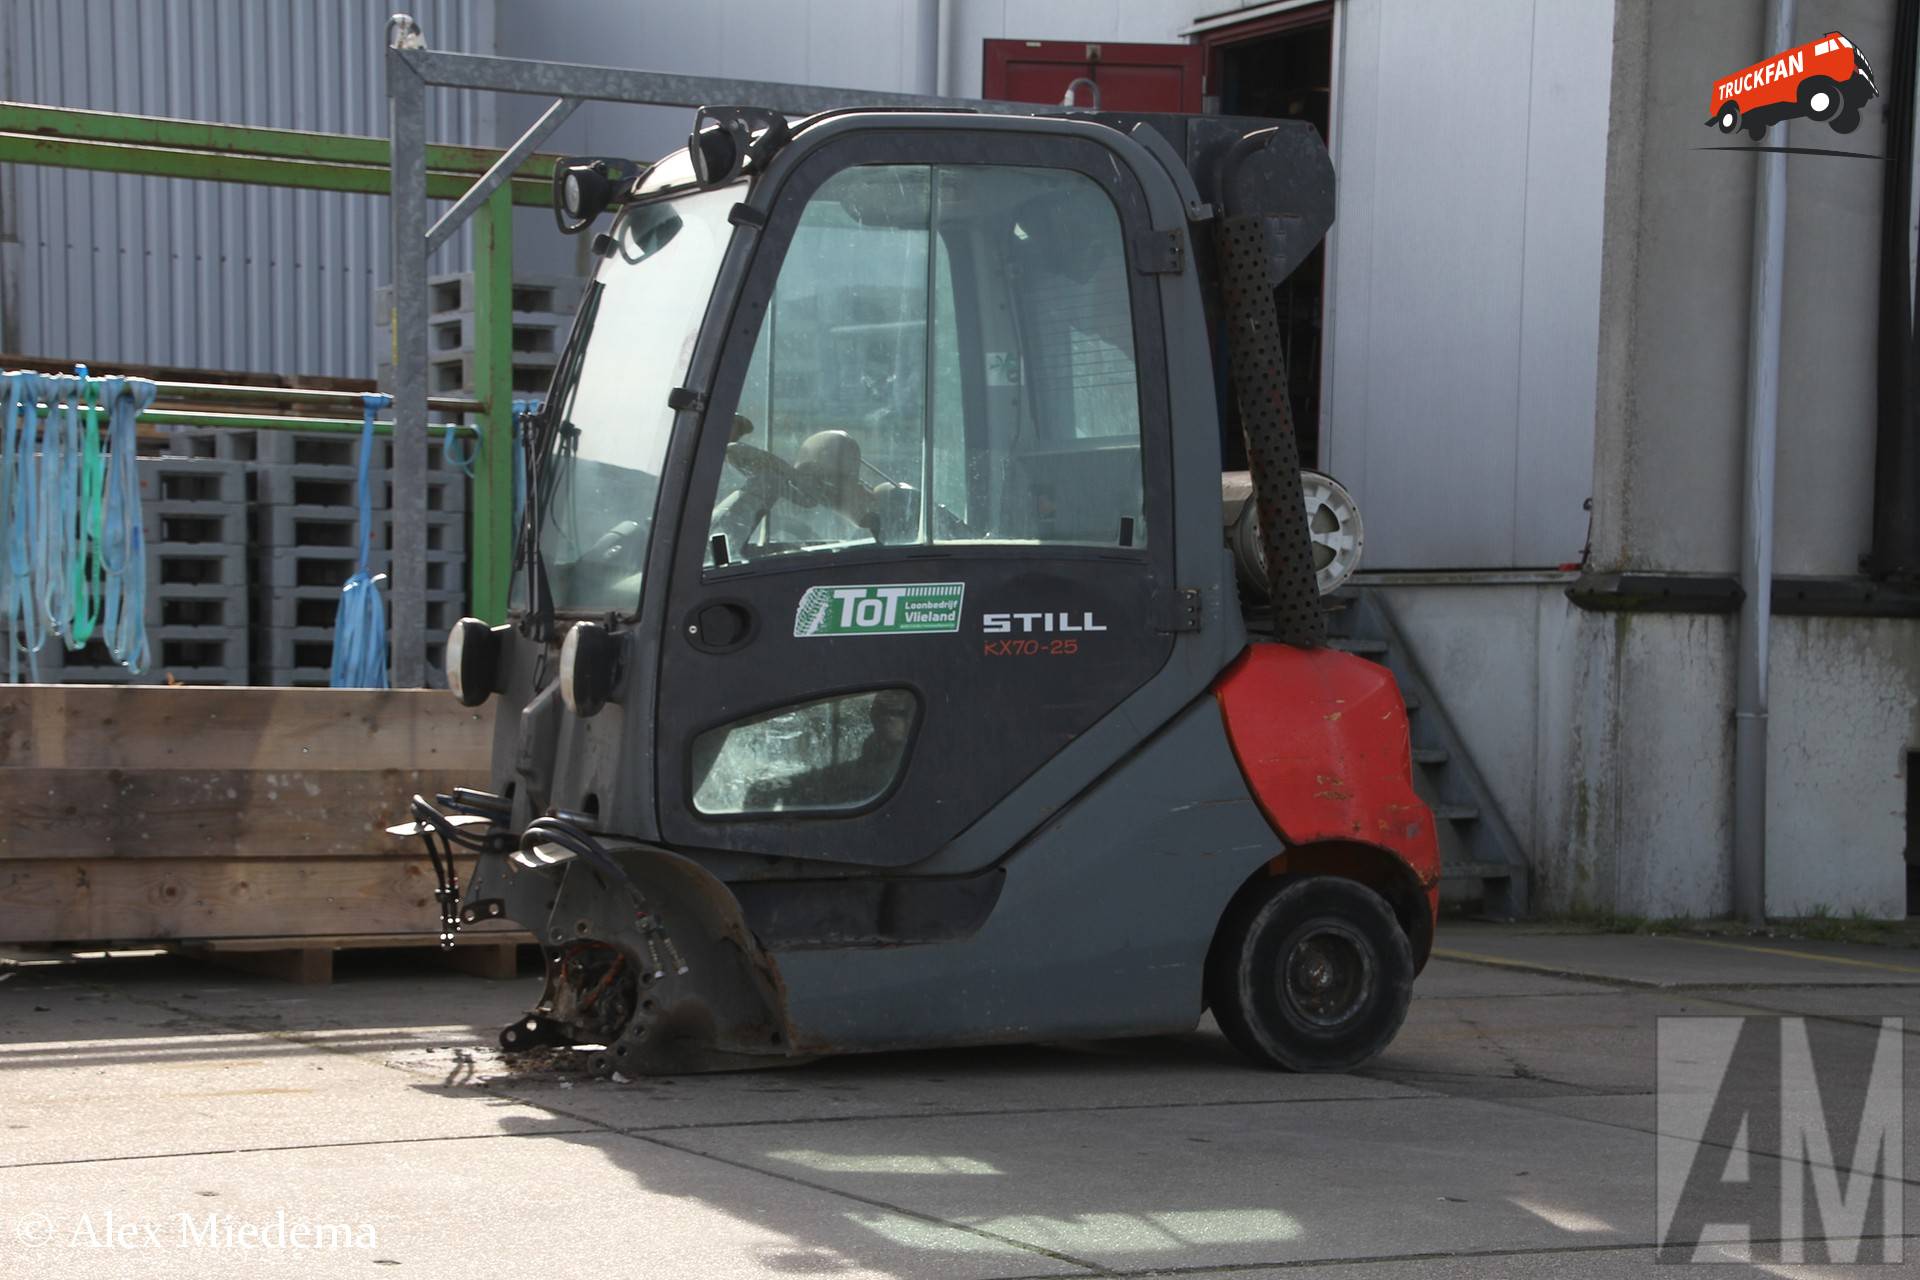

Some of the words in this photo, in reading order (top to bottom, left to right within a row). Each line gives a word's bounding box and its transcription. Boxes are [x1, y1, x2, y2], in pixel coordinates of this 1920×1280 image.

[905, 600, 958, 610] Loonbedrijf
[905, 611, 956, 623] Vlieland
[983, 612, 1107, 633] STILL
[984, 640, 1079, 656] KX70-25
